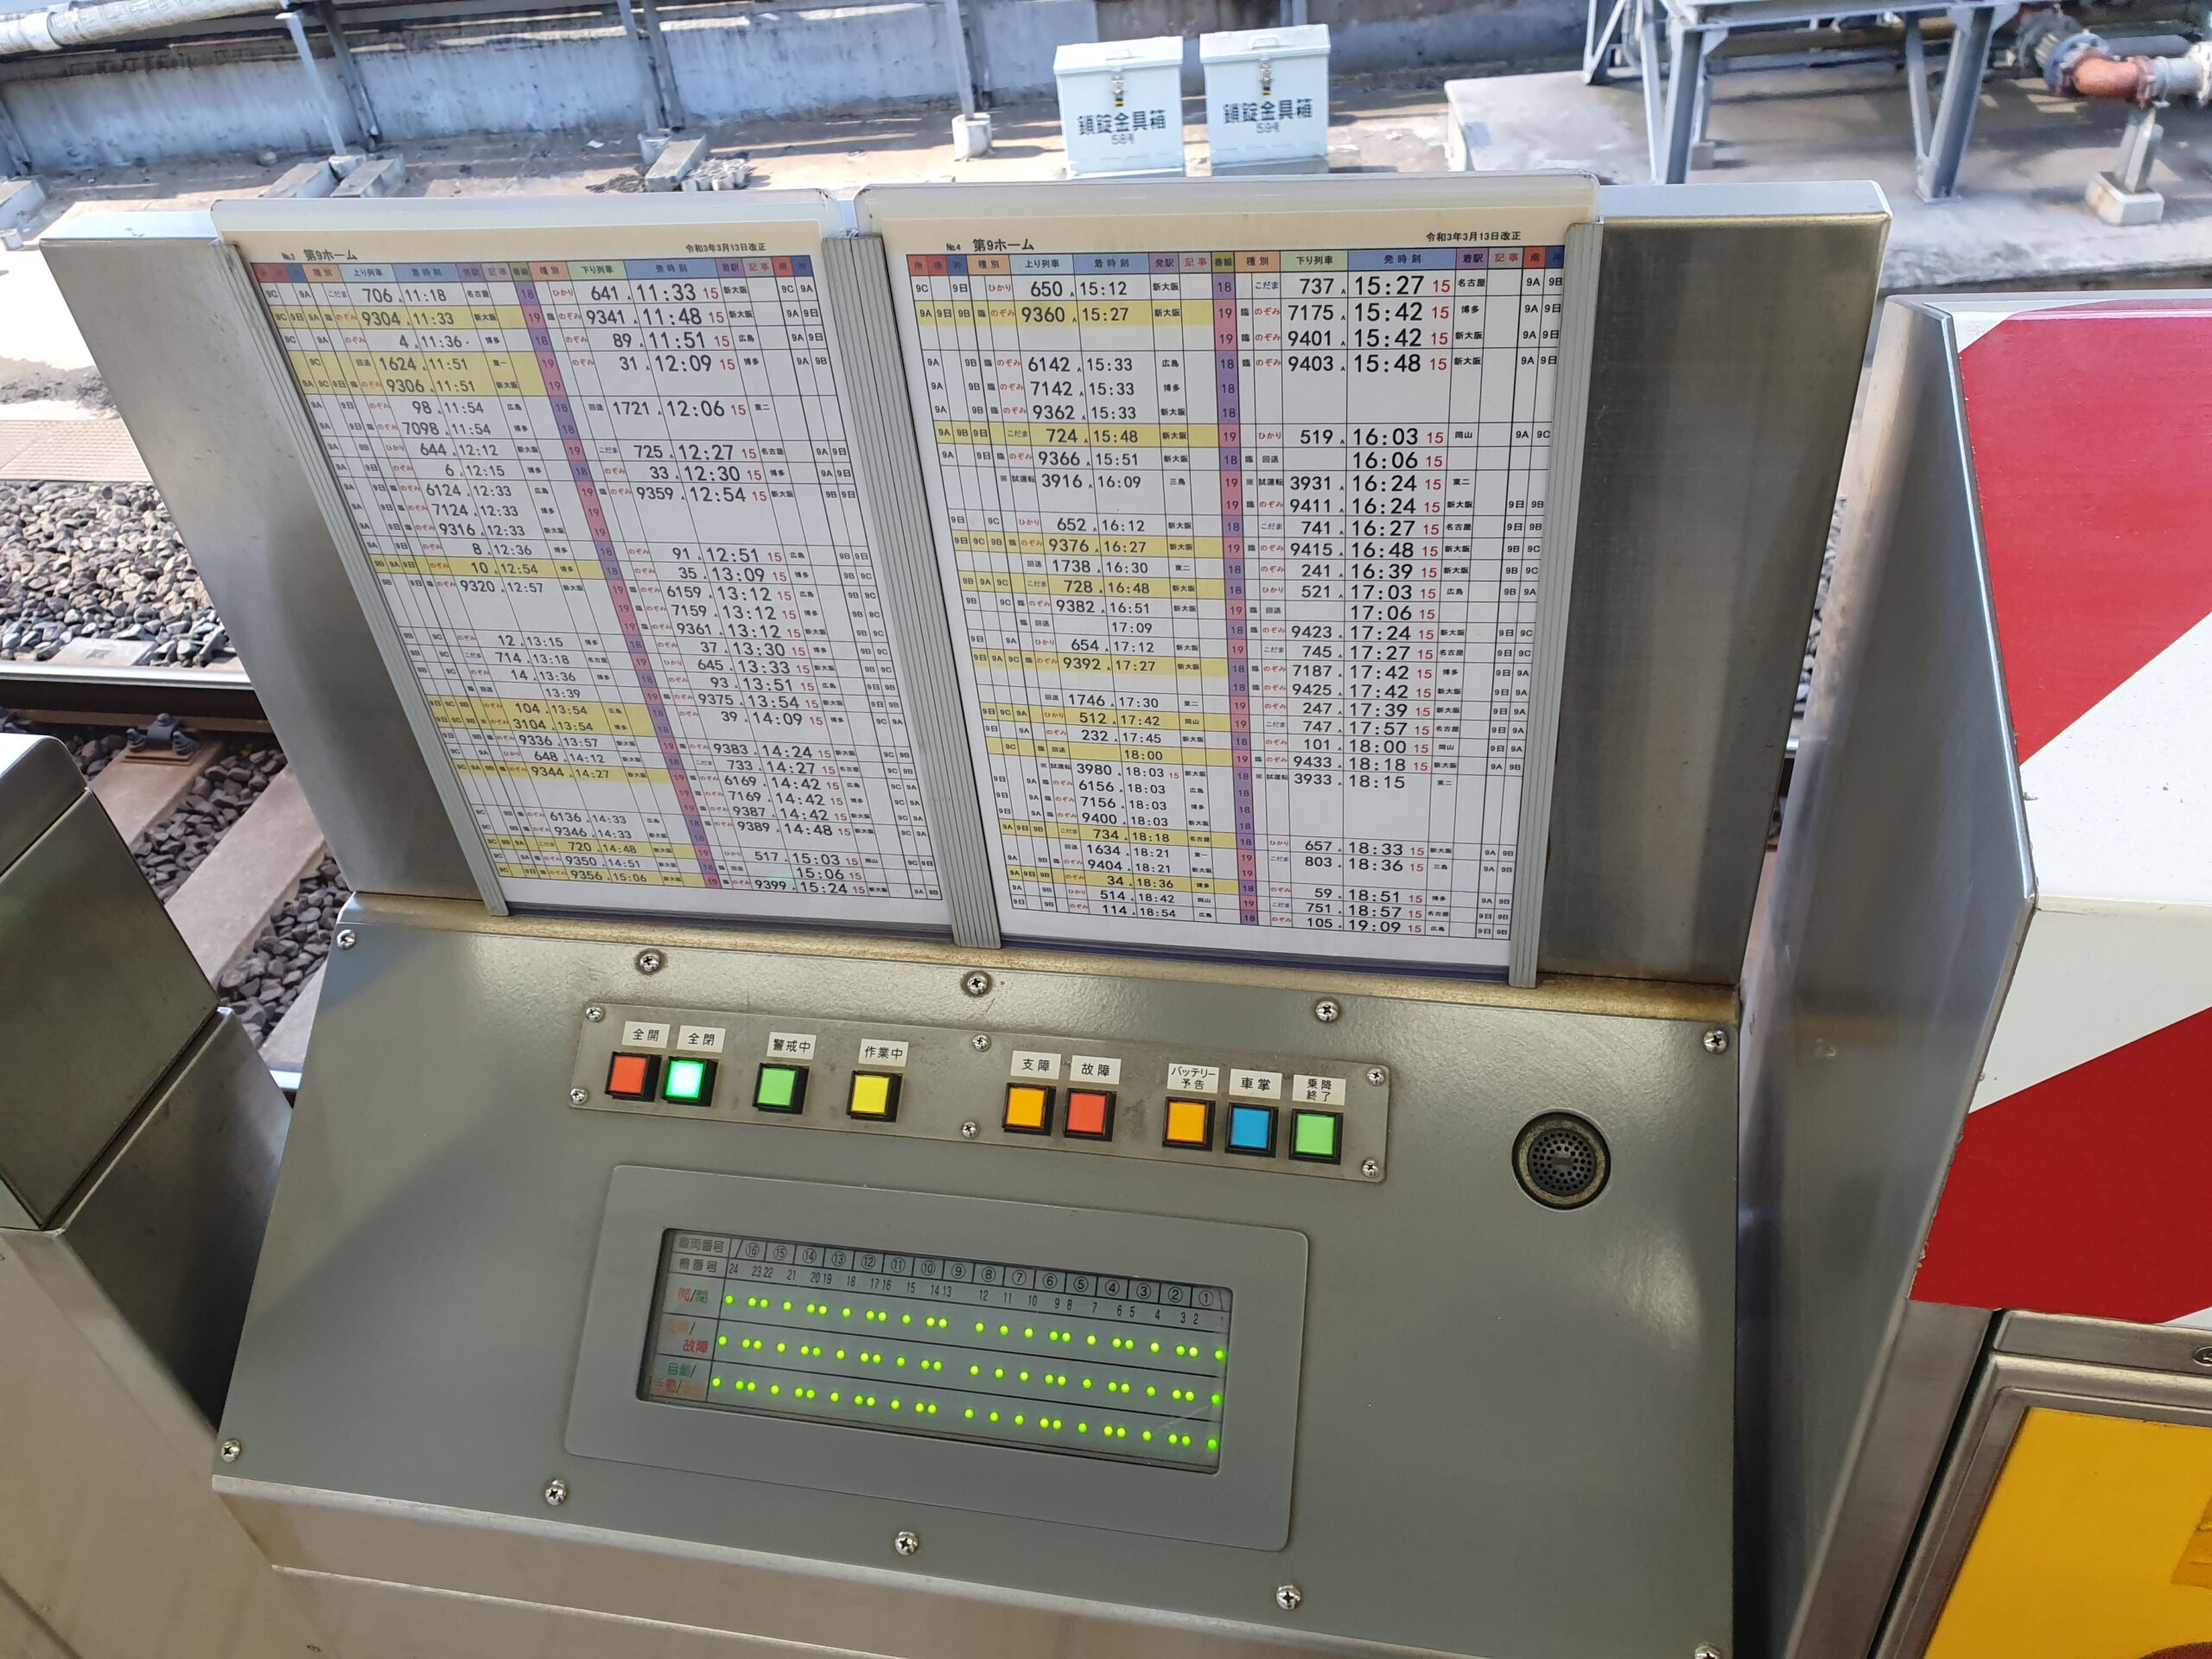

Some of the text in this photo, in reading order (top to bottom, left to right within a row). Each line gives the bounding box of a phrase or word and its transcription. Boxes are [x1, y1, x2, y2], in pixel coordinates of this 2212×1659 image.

[973, 238, 1034, 251] 第9ホーム
[1426, 232, 1521, 242] 令和3年3月13日改正
[303, 249, 358, 261] 第9ホーム
[685, 243, 766, 253] 令和3年3月13日改正
[1025, 259, 1059, 268] 上り列車
[1296, 256, 1332, 265] 下り列車
[1384, 254, 1421, 264] 発時刻
[581, 265, 613, 274] 下り列車
[362, 283, 748, 302] 706 11:18 641 11:33 15 新大阪
[952, 283, 968, 293] 9日
[1031, 281, 1063, 297] 650
[1080, 281, 1127, 296] 15:12
[1153, 283, 1179, 291] 新大阪
[1216, 280, 1233, 294] 18
[1254, 279, 1280, 290] こだま
[1300, 278, 1334, 295] 737
[1356, 276, 1424, 296] 15:27
[1432, 278, 1452, 293] 15
[1458, 278, 1485, 287] 名古屋
[1527, 277, 1541, 286] 9A
[1549, 277, 1563, 286] 9B
[361, 308, 702, 327] 9304 11:33 9341 11:48
[1021, 307, 1065, 322] 9360
[1083, 308, 1128, 321] 15:27
[1154, 308, 1179, 317] 新大阪
[1217, 306, 1234, 319] 19
[1288, 305, 1333, 321] 7175
[1355, 302, 1422, 321] 15:42
[1461, 305, 1479, 314] 博多
[422, 332, 705, 349] 11:36 89 11:51
[1288, 328, 1421, 347] 9401 15:42
[379, 354, 711, 372] 1624 11:51 31 12:09
[1028, 353, 1421, 372] 6142 15:33 9403 15:48
[1030, 381, 1072, 396] 7142
[1090, 382, 1135, 396] 15:33
[1033, 405, 1136, 420] 9362 15:33
[1046, 429, 1077, 442] 724
[1094, 429, 1138, 442] 15:48
[1300, 429, 1333, 444] 519
[1354, 428, 1418, 445] 16:03
[1042, 474, 1417, 492] 3916 16:09 3931 16:24
[1058, 518, 1415, 538] 652 16:12 741 16:27
[1049, 538, 1414, 558] 9376 16:27 9415 16:48
[1052, 559, 1413, 579] 1738 16:30 241 16:39
[460, 580, 772, 601] 9320 12:57 13:12
[1350, 605, 1412, 622] 17:06
[1116, 660, 1408, 679] 17:27 7187 17:42
[518, 734, 812, 759] 9336 13:57 14:24
[1294, 756, 1406, 772] 9433 18:18
[1080, 796, 1166, 810] 7156 18:03
[570, 869, 848, 893] 9356 15:06 9399 15:24
[1103, 905, 1401, 932] 114 18:54 105 19:09
[632, 1028, 659, 1041] 全開
[688, 1033, 715, 1046] 全閉
[773, 1039, 810, 1052] 警戒中
[865, 1046, 903, 1060] 作業中
[1021, 1058, 1050, 1071] 支障
[1082, 1063, 1110, 1077] 故障
[1172, 1066, 1216, 1078] バッテリー
[1181, 1078, 1205, 1090] 予告
[1241, 1077, 1270, 1091] 車掌
[1306, 1078, 1332, 1090] 乗降
[1306, 1090, 1331, 1102] 終了
[728, 1263, 739, 1274] 24
[751, 1265, 762, 1277] 23
[763, 1267, 774, 1279] 22
[787, 1268, 797, 1281] 21
[810, 1271, 821, 1283] 20
[823, 1274, 832, 1285] 19
[847, 1275, 856, 1287] 18
[870, 1277, 880, 1289] 17
[882, 1279, 892, 1291] 16
[906, 1281, 916, 1294] 15
[931, 1284, 940, 1297] 14
[943, 1286, 951, 1298] 13
[979, 1289, 988, 1301] 12
[1003, 1292, 1013, 1303] 11
[1028, 1294, 1038, 1307] 10
[1054, 1298, 1059, 1309] 9
[1066, 1300, 1072, 1311] 8
[1092, 1302, 1097, 1313] 7
[1116, 1305, 1122, 1317] 6
[1129, 1306, 1135, 1318] 5
[1154, 1309, 1160, 1320] 4
[1180, 1312, 1186, 1324] 3
[1193, 1313, 1199, 1325] 2
[682, 1339, 709, 1354] 故障
